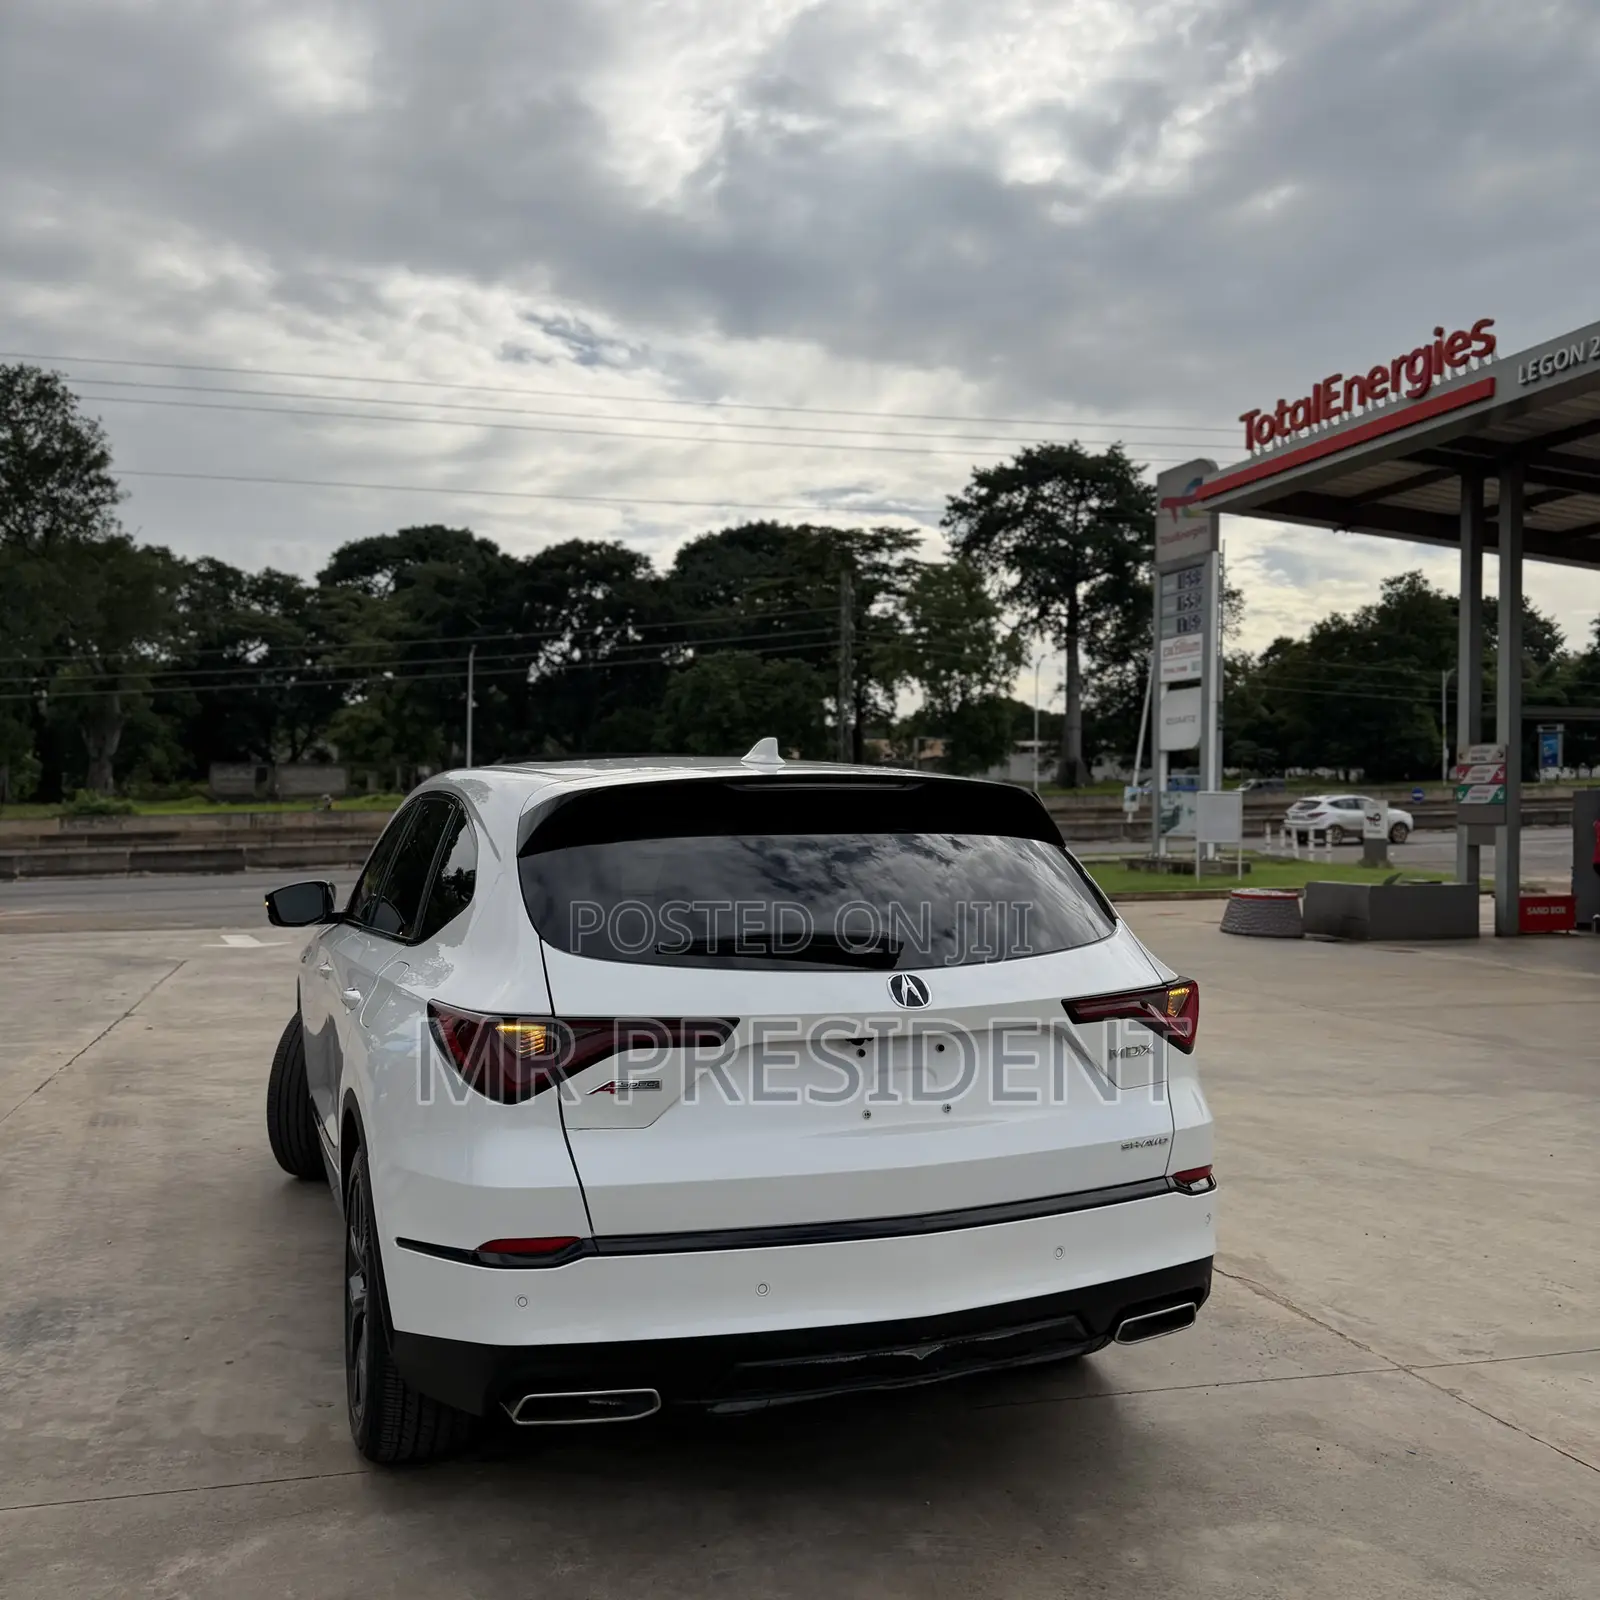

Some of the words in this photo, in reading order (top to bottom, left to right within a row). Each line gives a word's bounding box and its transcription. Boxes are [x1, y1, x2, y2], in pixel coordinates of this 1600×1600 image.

[1239, 318, 1497, 450] TotalEnergies
[1517, 341, 1585, 384] LEGON
[1108, 1042, 1154, 1061] MDX
